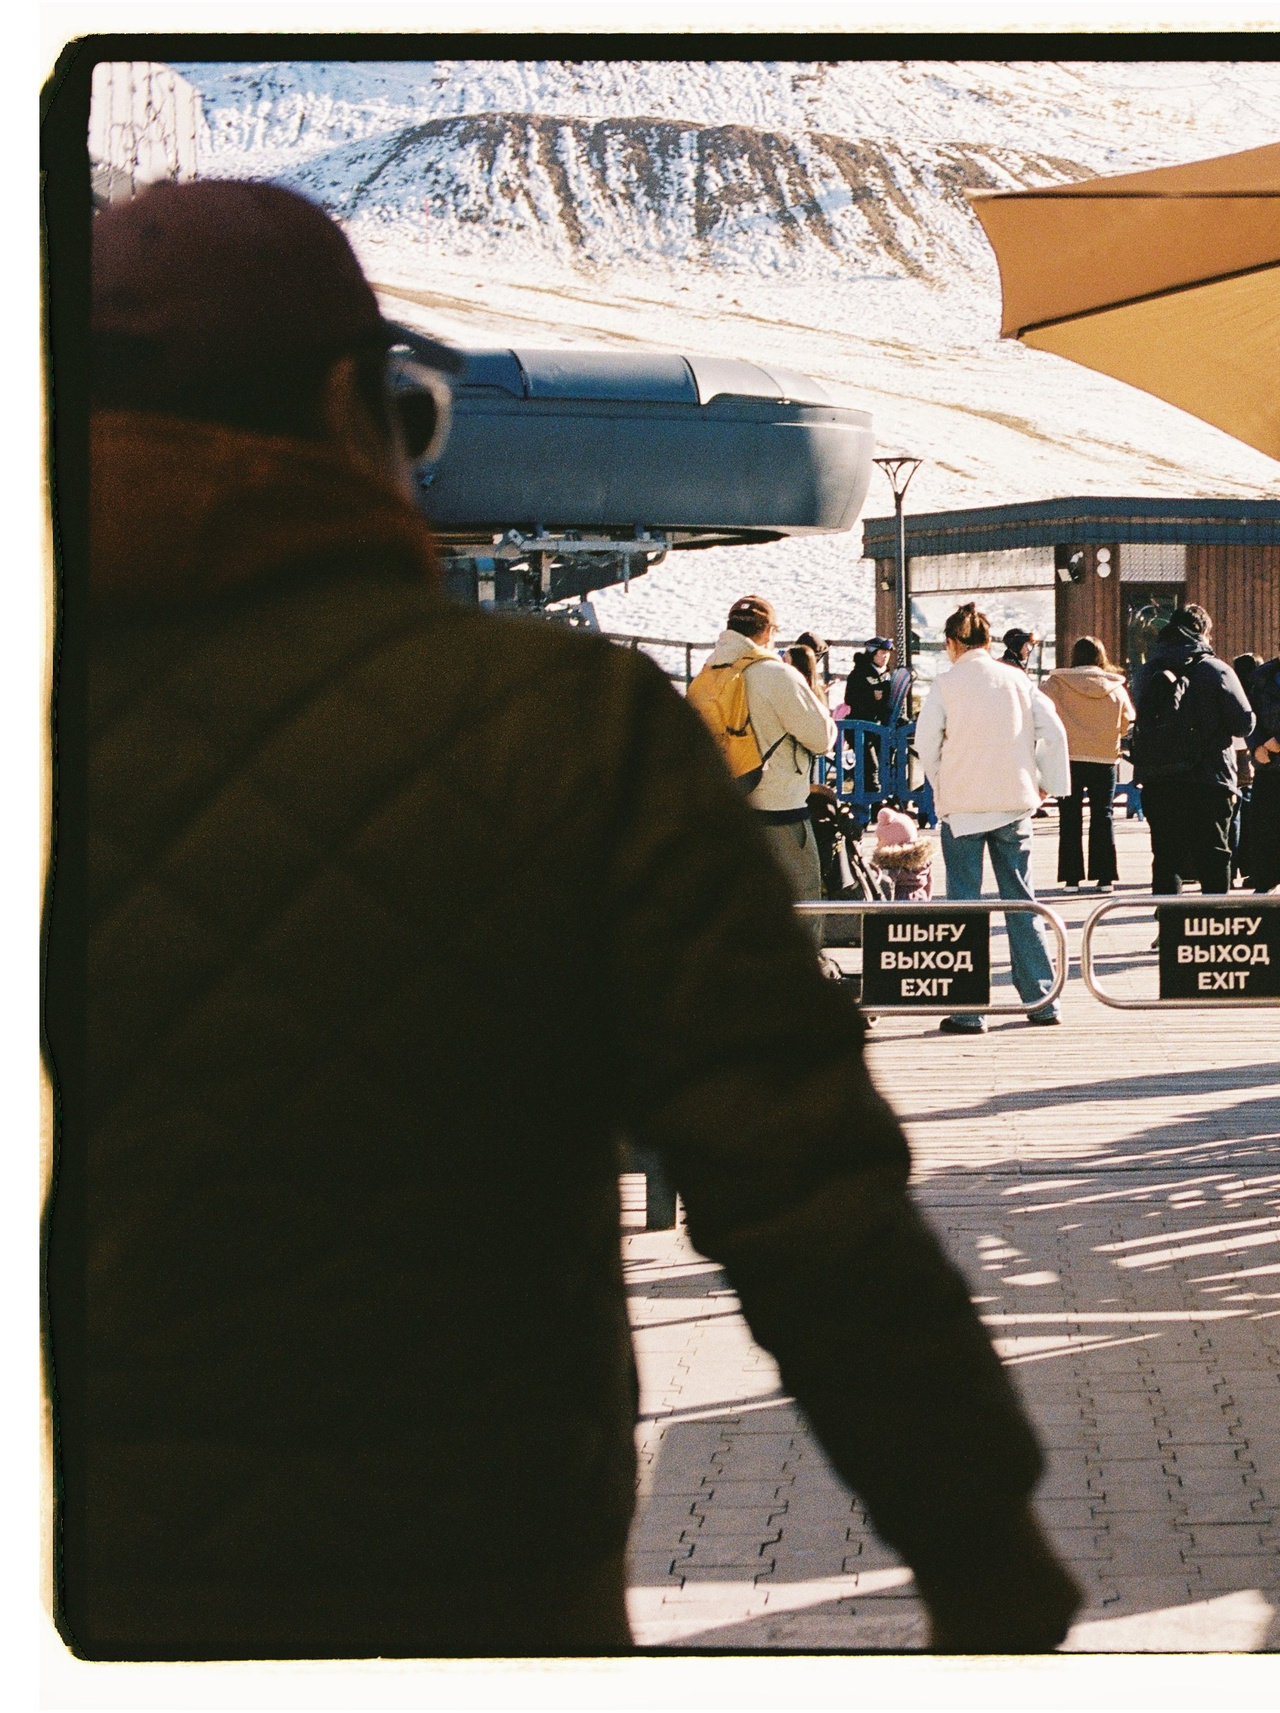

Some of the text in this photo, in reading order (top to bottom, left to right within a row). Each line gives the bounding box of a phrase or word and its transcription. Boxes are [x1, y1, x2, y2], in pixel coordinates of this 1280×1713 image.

[888, 923, 966, 942] ШЫҒУ
[1184, 916, 1262, 936] ШЫҒУ
[880, 950, 974, 973] ВЫХОД
[1177, 944, 1270, 966] ВЫХОД
[901, 978, 954, 997] EXIT
[1198, 971, 1250, 990] EXIT
